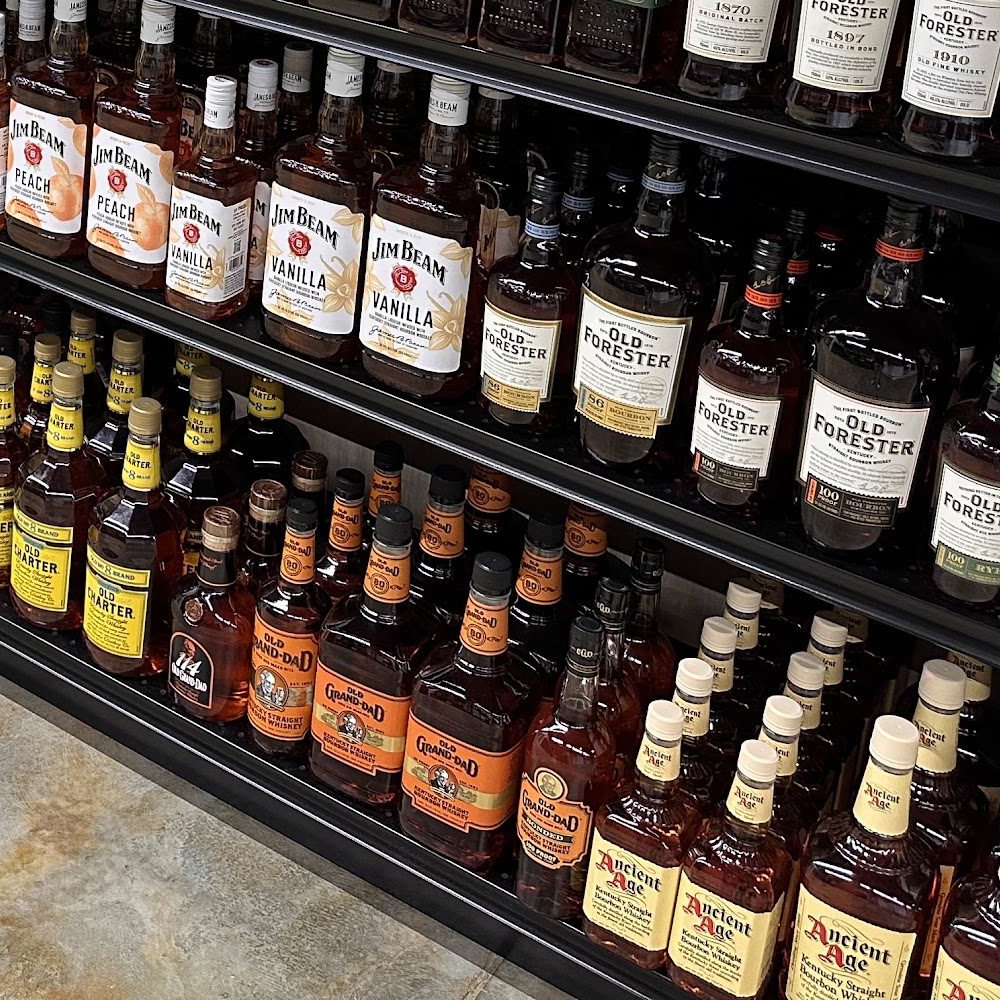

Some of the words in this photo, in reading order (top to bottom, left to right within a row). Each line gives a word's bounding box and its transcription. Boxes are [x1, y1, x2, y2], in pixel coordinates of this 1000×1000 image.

[715, 1, 751, 15] 1870
[943, 10, 972, 25] OLD
[827, 30, 865, 43] 1897
[920, 13, 998, 41] FORESTER
[933, 50, 970, 65] 1910
[10, 118, 30, 141] JIM
[30, 120, 66, 158] BEAM
[15, 167, 50, 191] PEACH
[93, 145, 114, 168] JIM
[115, 147, 153, 185] BEAM
[97, 195, 136, 222] PEACH
[271, 203, 296, 228] JIM
[297, 206, 339, 251] BEAM
[171, 244, 214, 271] VANILLA
[372, 237, 400, 264] JIM
[401, 241, 448, 286] BEAM
[271, 255, 328, 292] VANILLA
[372, 290, 434, 329] VANILLA
[485, 326, 548, 360] FORESTER
[500, 328, 525, 345] OLD
[584, 325, 672, 368] FORESTER
[609, 328, 642, 348] OLD
[699, 400, 770, 437] FORESTER
[718, 403, 745, 421] OLD
[846, 414, 884, 436] OLD
[814, 413, 916, 456] FORESTER
[818, 485, 840, 502] 100
[14, 545, 60, 575] CHARTER
[112, 572, 135, 581] BRAND
[373, 578, 385, 589] 80
[87, 587, 135, 619] CHARTER
[469, 628, 482, 640] 80
[325, 683, 385, 723] GRAND-DAD
[416, 736, 479, 778] GRAND-DAD
[595, 849, 662, 893] Ancient
[682, 892, 753, 938] Ancient
[804, 915, 892, 966] Ancient
[800, 954, 843, 986] Kentucky
[846, 977, 886, 998] Straight
